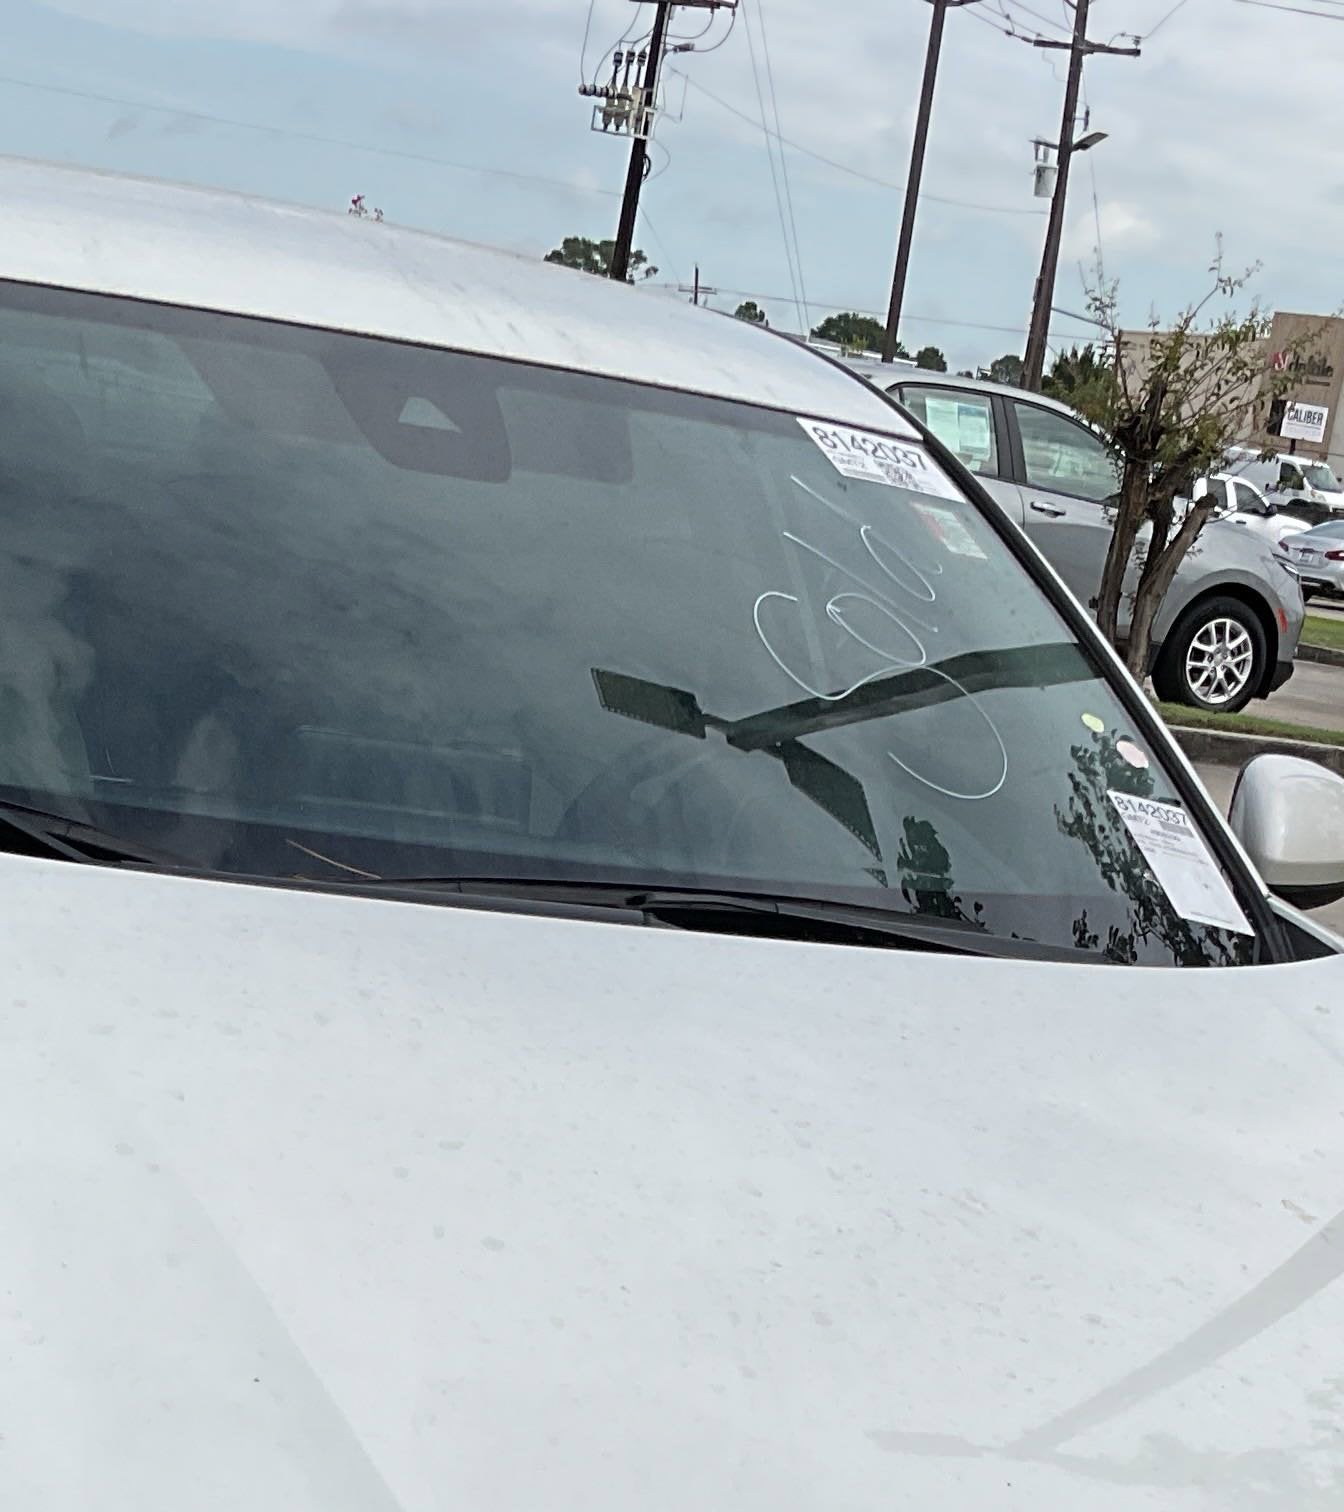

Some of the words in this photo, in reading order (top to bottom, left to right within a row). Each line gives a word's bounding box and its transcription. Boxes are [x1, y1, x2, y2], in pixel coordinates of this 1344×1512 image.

[1287, 408, 1324, 426] CALIBER
[811, 426, 927, 471] 8142037
[1114, 796, 1188, 826] 8142037
